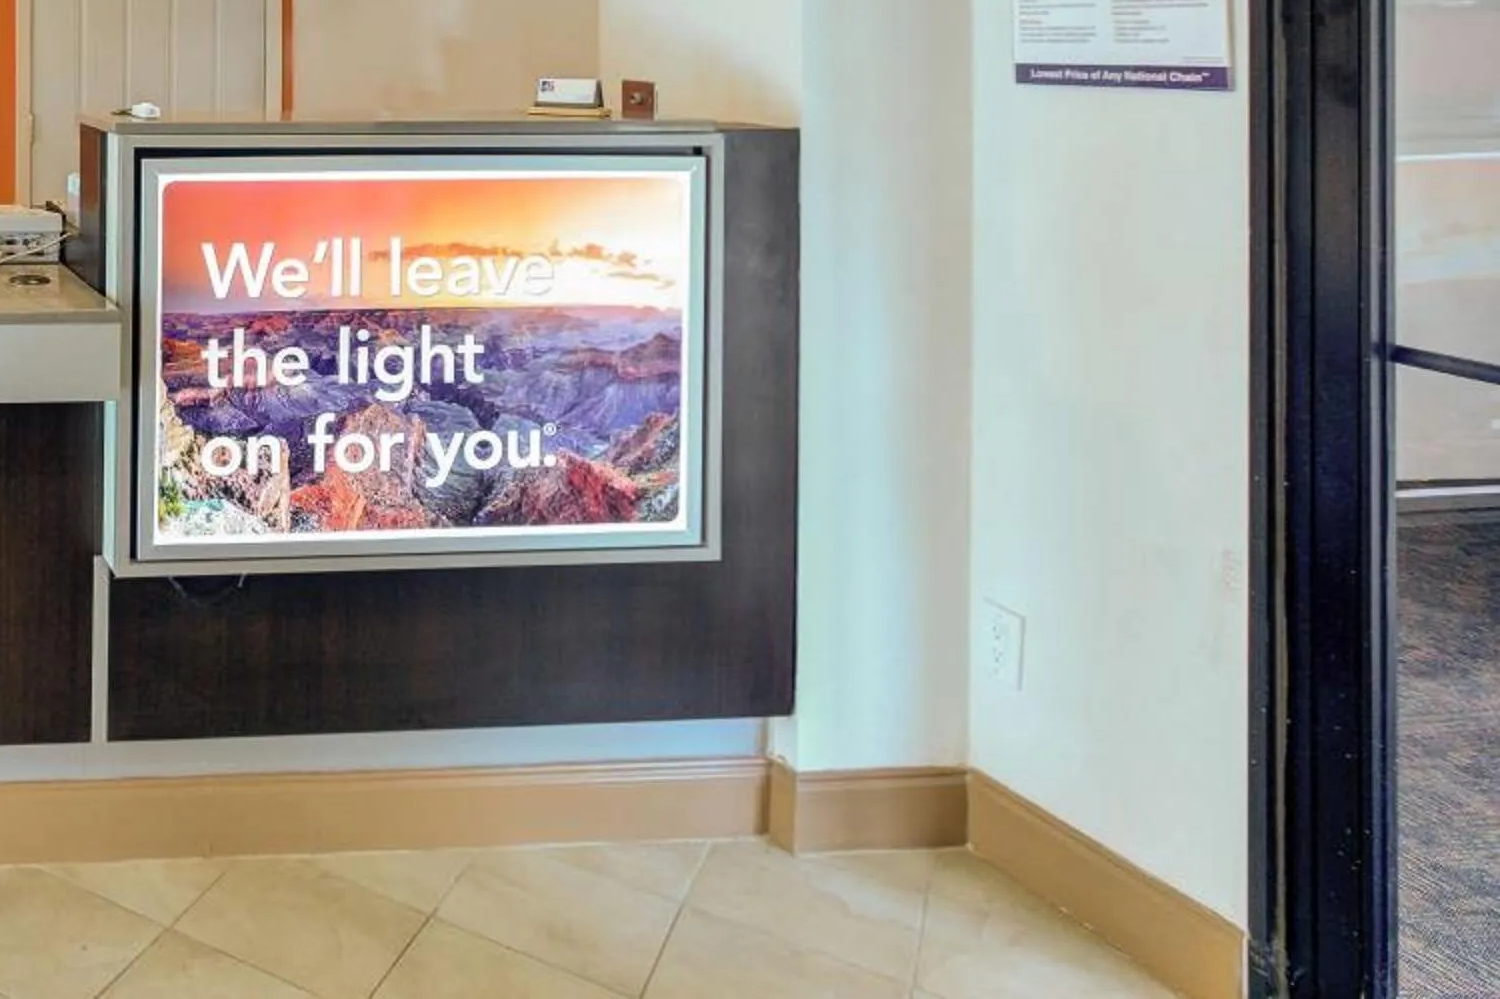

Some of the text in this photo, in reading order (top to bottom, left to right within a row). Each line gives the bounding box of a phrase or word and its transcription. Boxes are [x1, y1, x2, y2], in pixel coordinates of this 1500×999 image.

[1030, 68, 1063, 79] Lowest
[1065, 69, 1088, 81] Price
[1090, 70, 1101, 81] of
[1102, 71, 1122, 83] Any
[1124, 71, 1167, 83] National
[201, 236, 555, 299] We'll leave
[201, 324, 486, 402] the light
[201, 435, 281, 477] on
[307, 412, 405, 474] for
